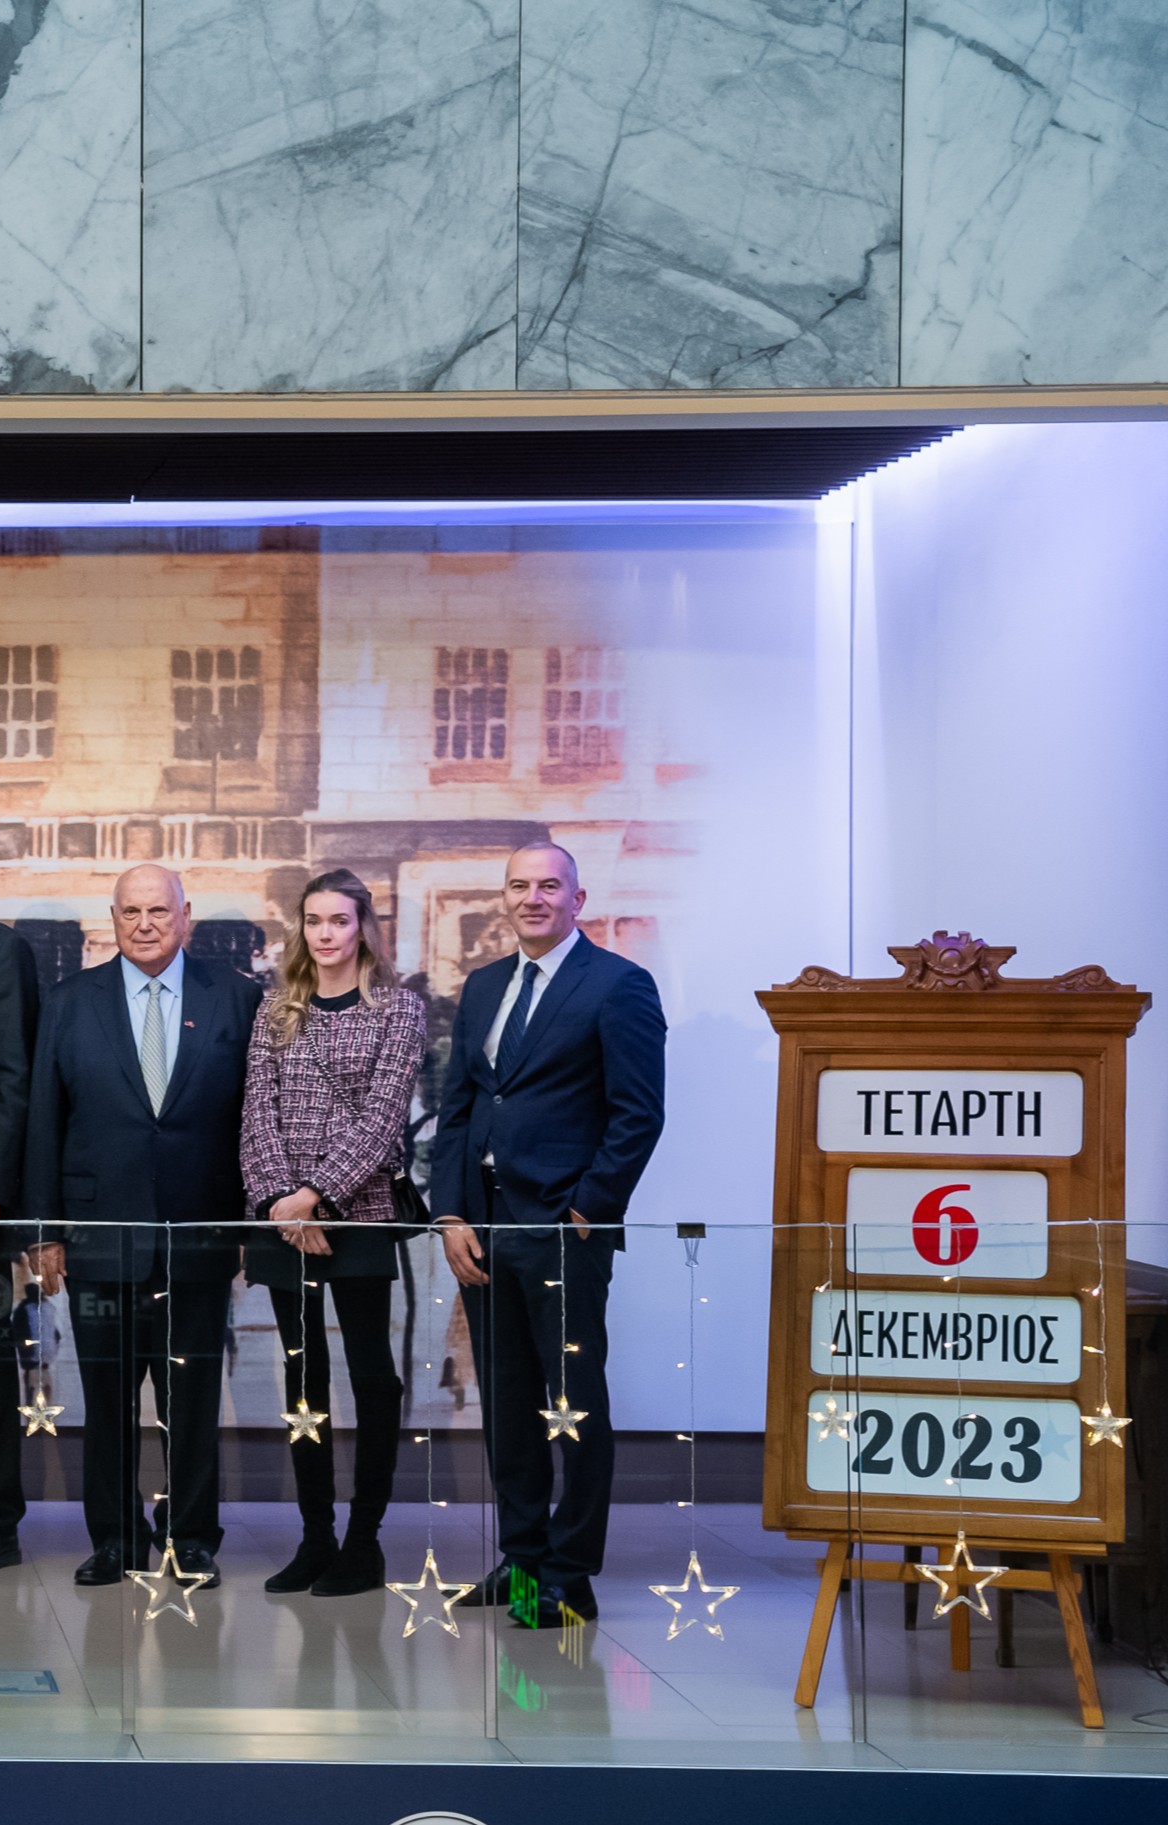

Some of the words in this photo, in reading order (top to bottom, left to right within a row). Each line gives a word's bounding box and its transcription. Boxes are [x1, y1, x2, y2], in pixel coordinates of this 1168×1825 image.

[856, 1089, 1042, 1137] ΤΕΤΑΡΤΗ
[912, 1183, 979, 1267] 6
[832, 1309, 1060, 1364] ΔΕΚΕΜΒΡΙΟΣ
[851, 1408, 1043, 1484] 2023
